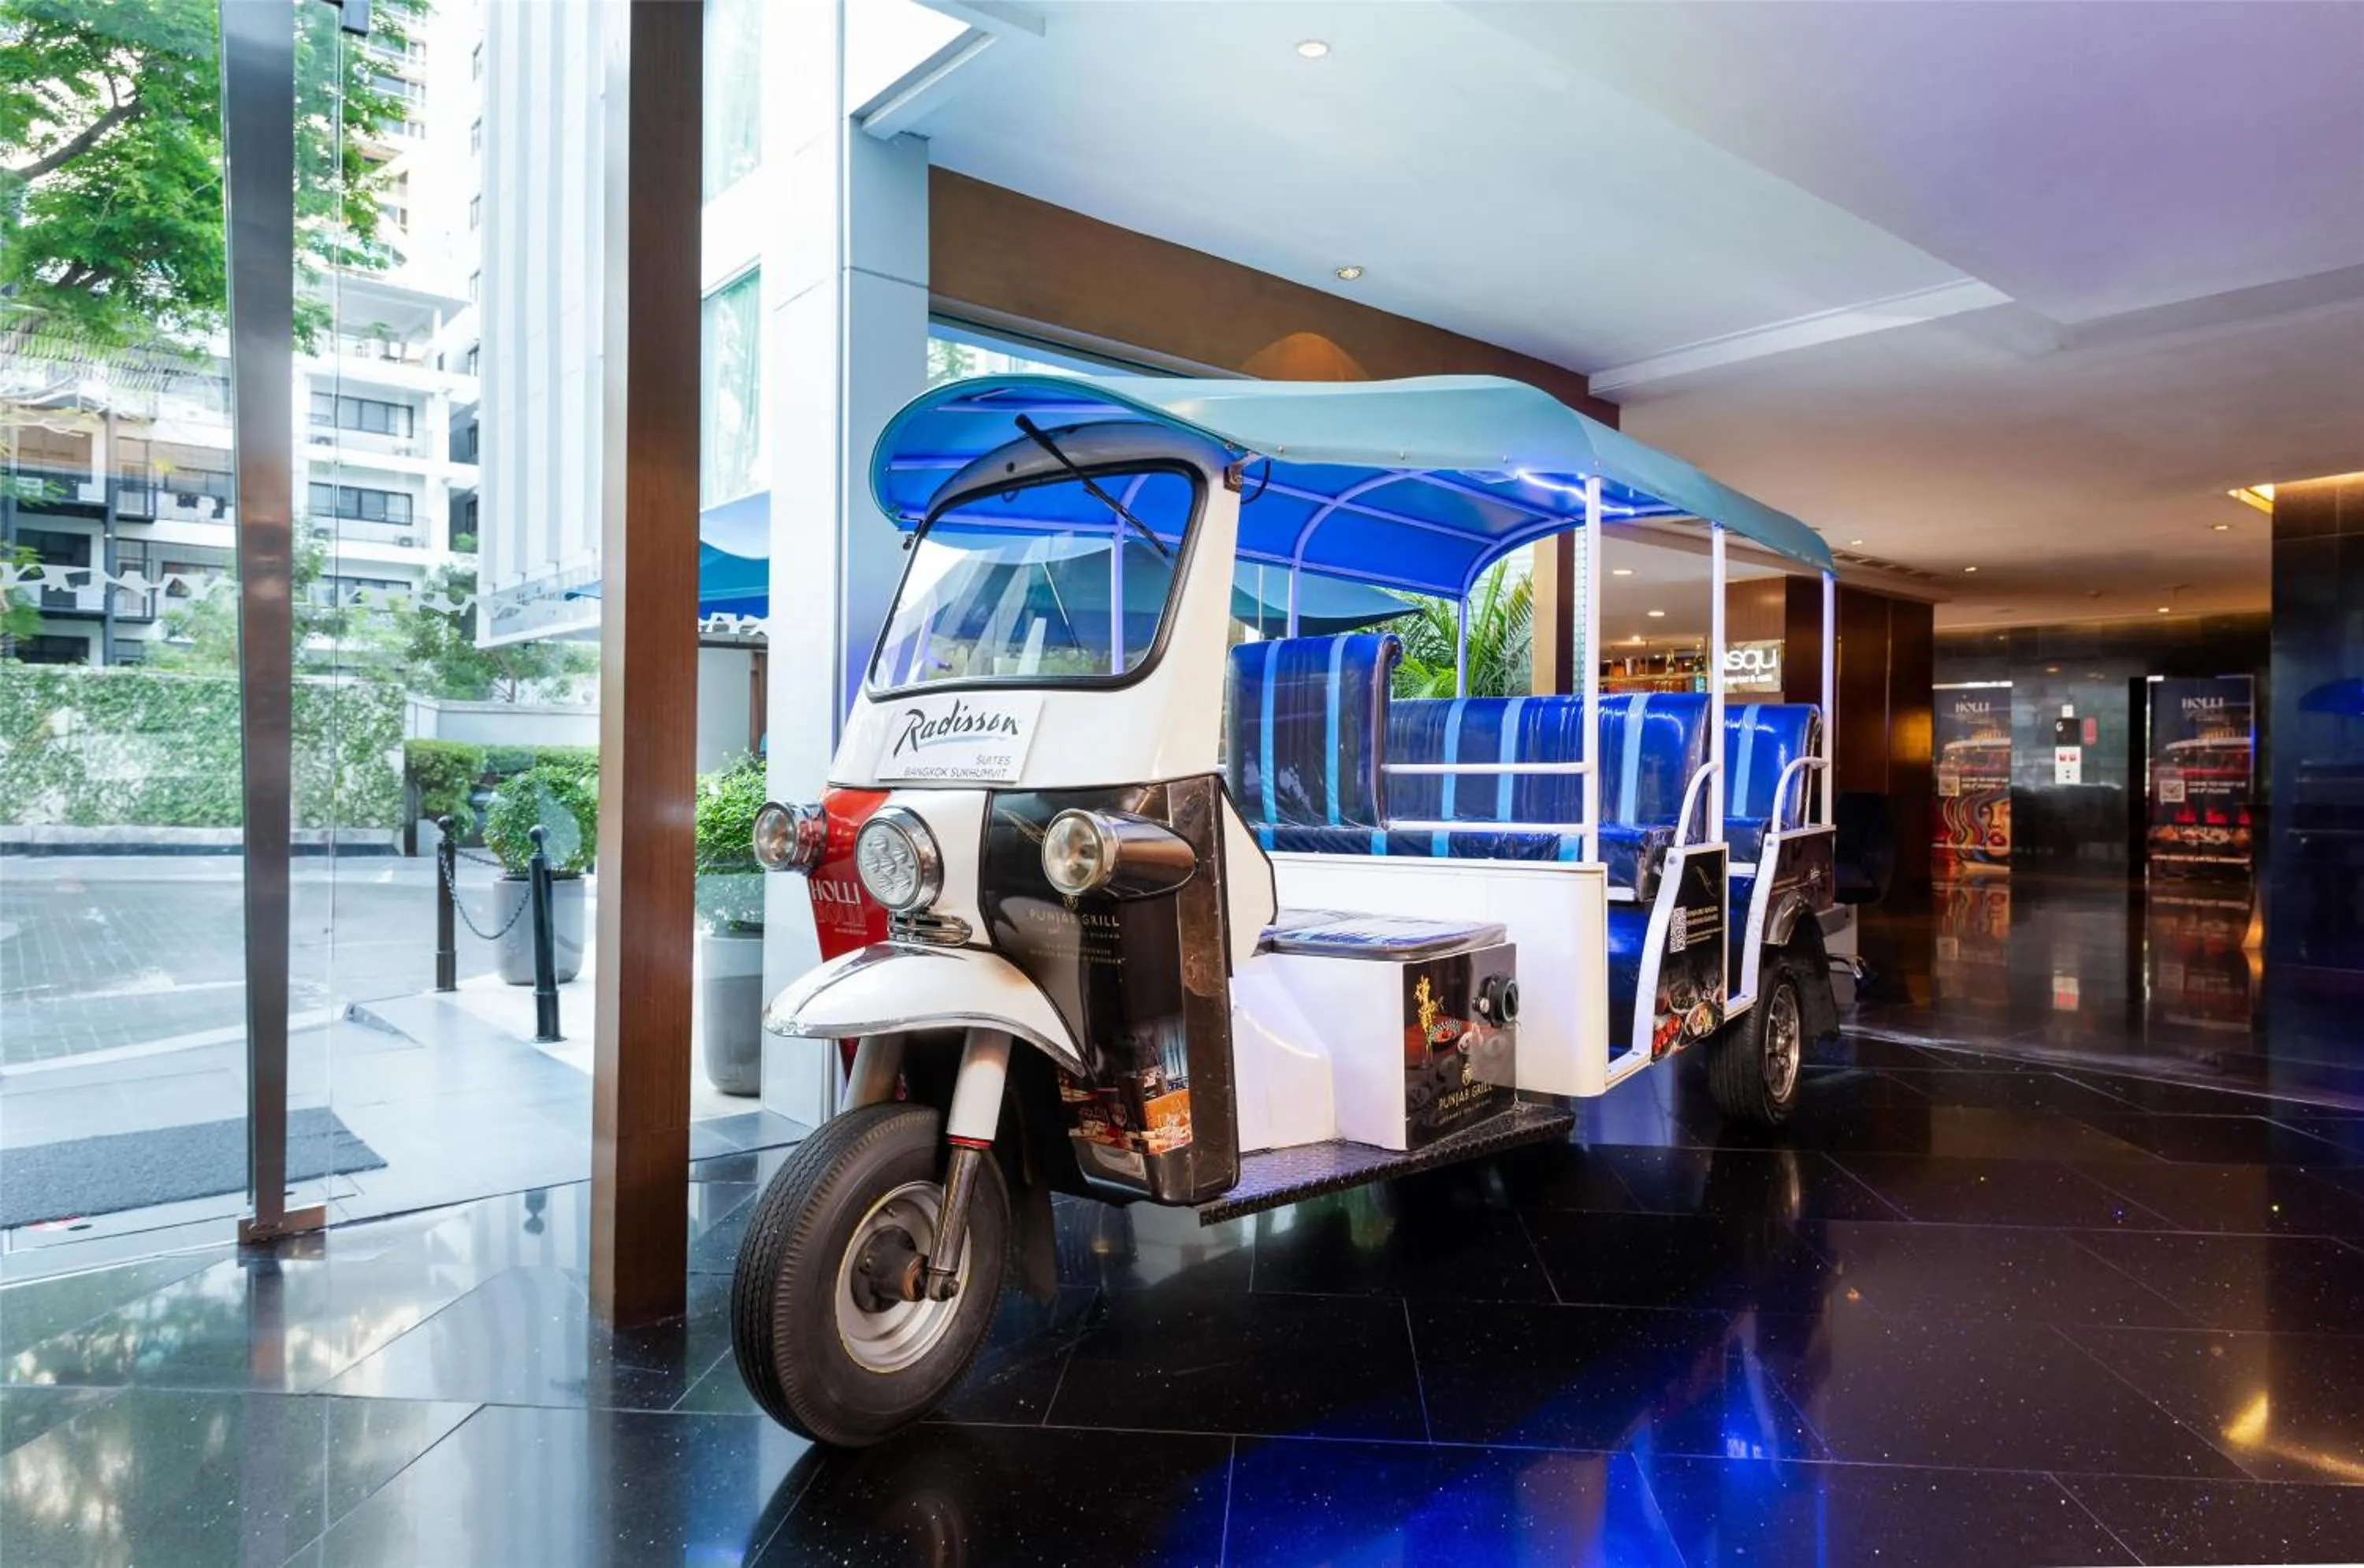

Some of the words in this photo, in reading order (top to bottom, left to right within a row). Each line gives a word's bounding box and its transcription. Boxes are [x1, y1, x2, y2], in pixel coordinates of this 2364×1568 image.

[894, 698, 1019, 757] Radisson
[976, 755, 1011, 765] SUITES
[905, 767, 947, 776] BANGKOK
[809, 879, 860, 905] HOLLI
[1028, 908, 1076, 926] PUNJAB
[1081, 914, 1120, 927] GRILL
